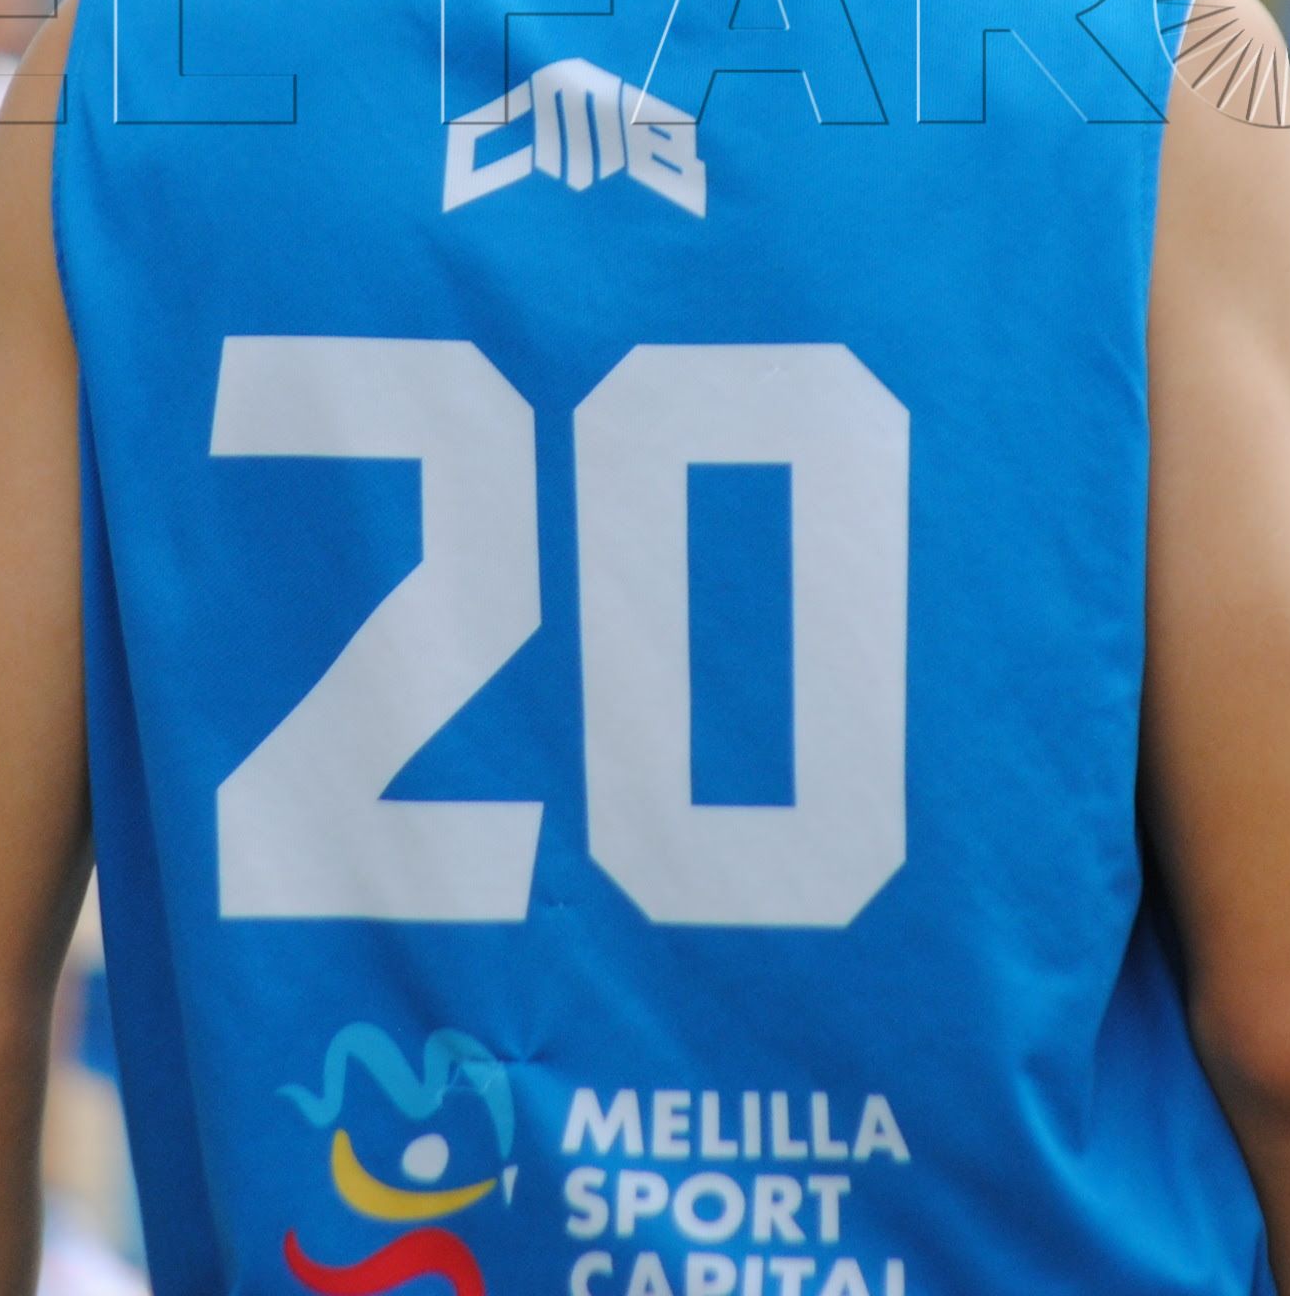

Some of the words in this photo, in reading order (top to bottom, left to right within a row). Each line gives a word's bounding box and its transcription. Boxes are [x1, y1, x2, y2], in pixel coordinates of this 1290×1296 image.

[442, 57, 707, 219] CMB
[208, 334, 911, 930] 20
[561, 1087, 912, 1162] MELILLA
[564, 1166, 851, 1244] SPORT
